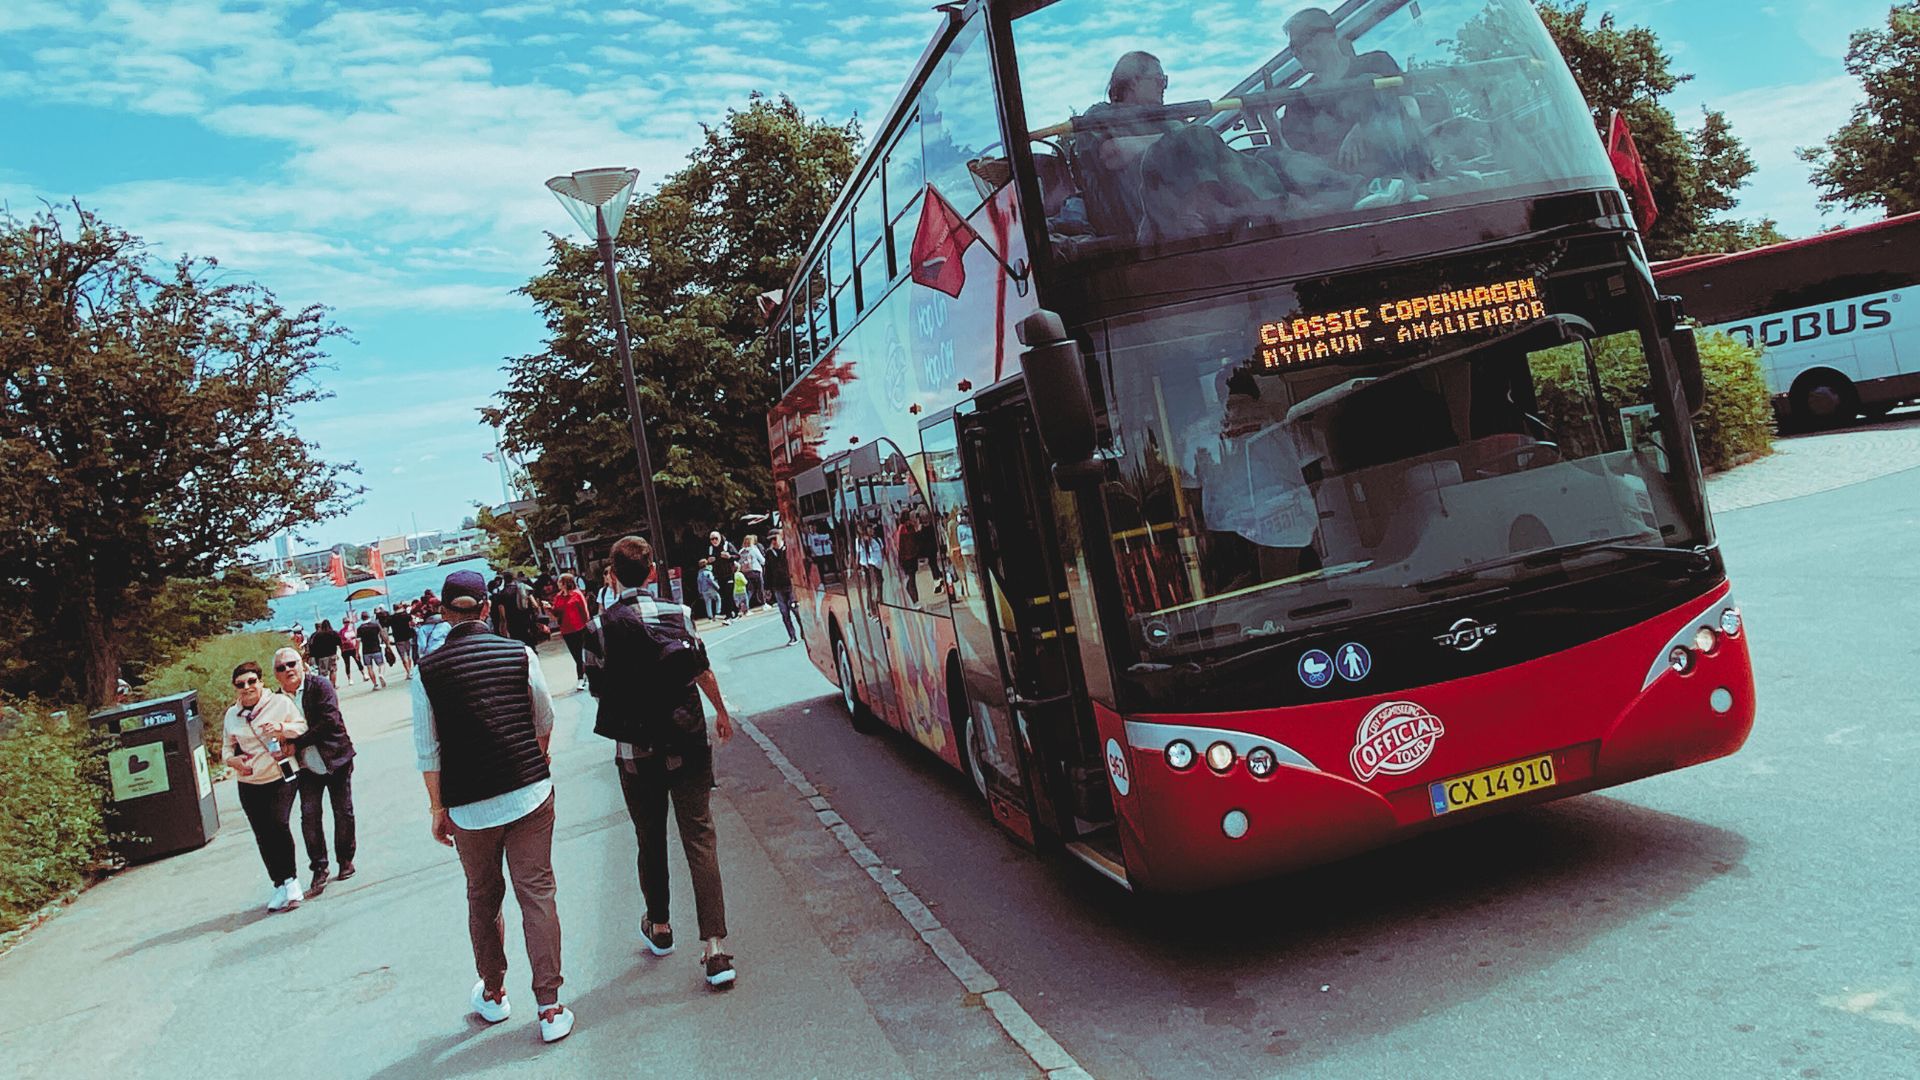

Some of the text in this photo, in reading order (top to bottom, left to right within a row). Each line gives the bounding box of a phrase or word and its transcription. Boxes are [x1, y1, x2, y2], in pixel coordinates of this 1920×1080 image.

[917, 304, 934, 339] Hop
[1259, 277, 1537, 346] CLASSIC COPENHAGEN
[1262, 333, 1363, 369] NYHAVN
[1397, 300, 1547, 343] AMALIENBOR
[923, 353, 941, 389] Hop
[1378, 704, 1420, 722] SIGHTSEEING
[1361, 717, 1441, 766] OFFICIAL
[1396, 739, 1429, 764] TOUR
[1109, 754, 1128, 781] 962
[1448, 759, 1553, 806] CX 14 910
